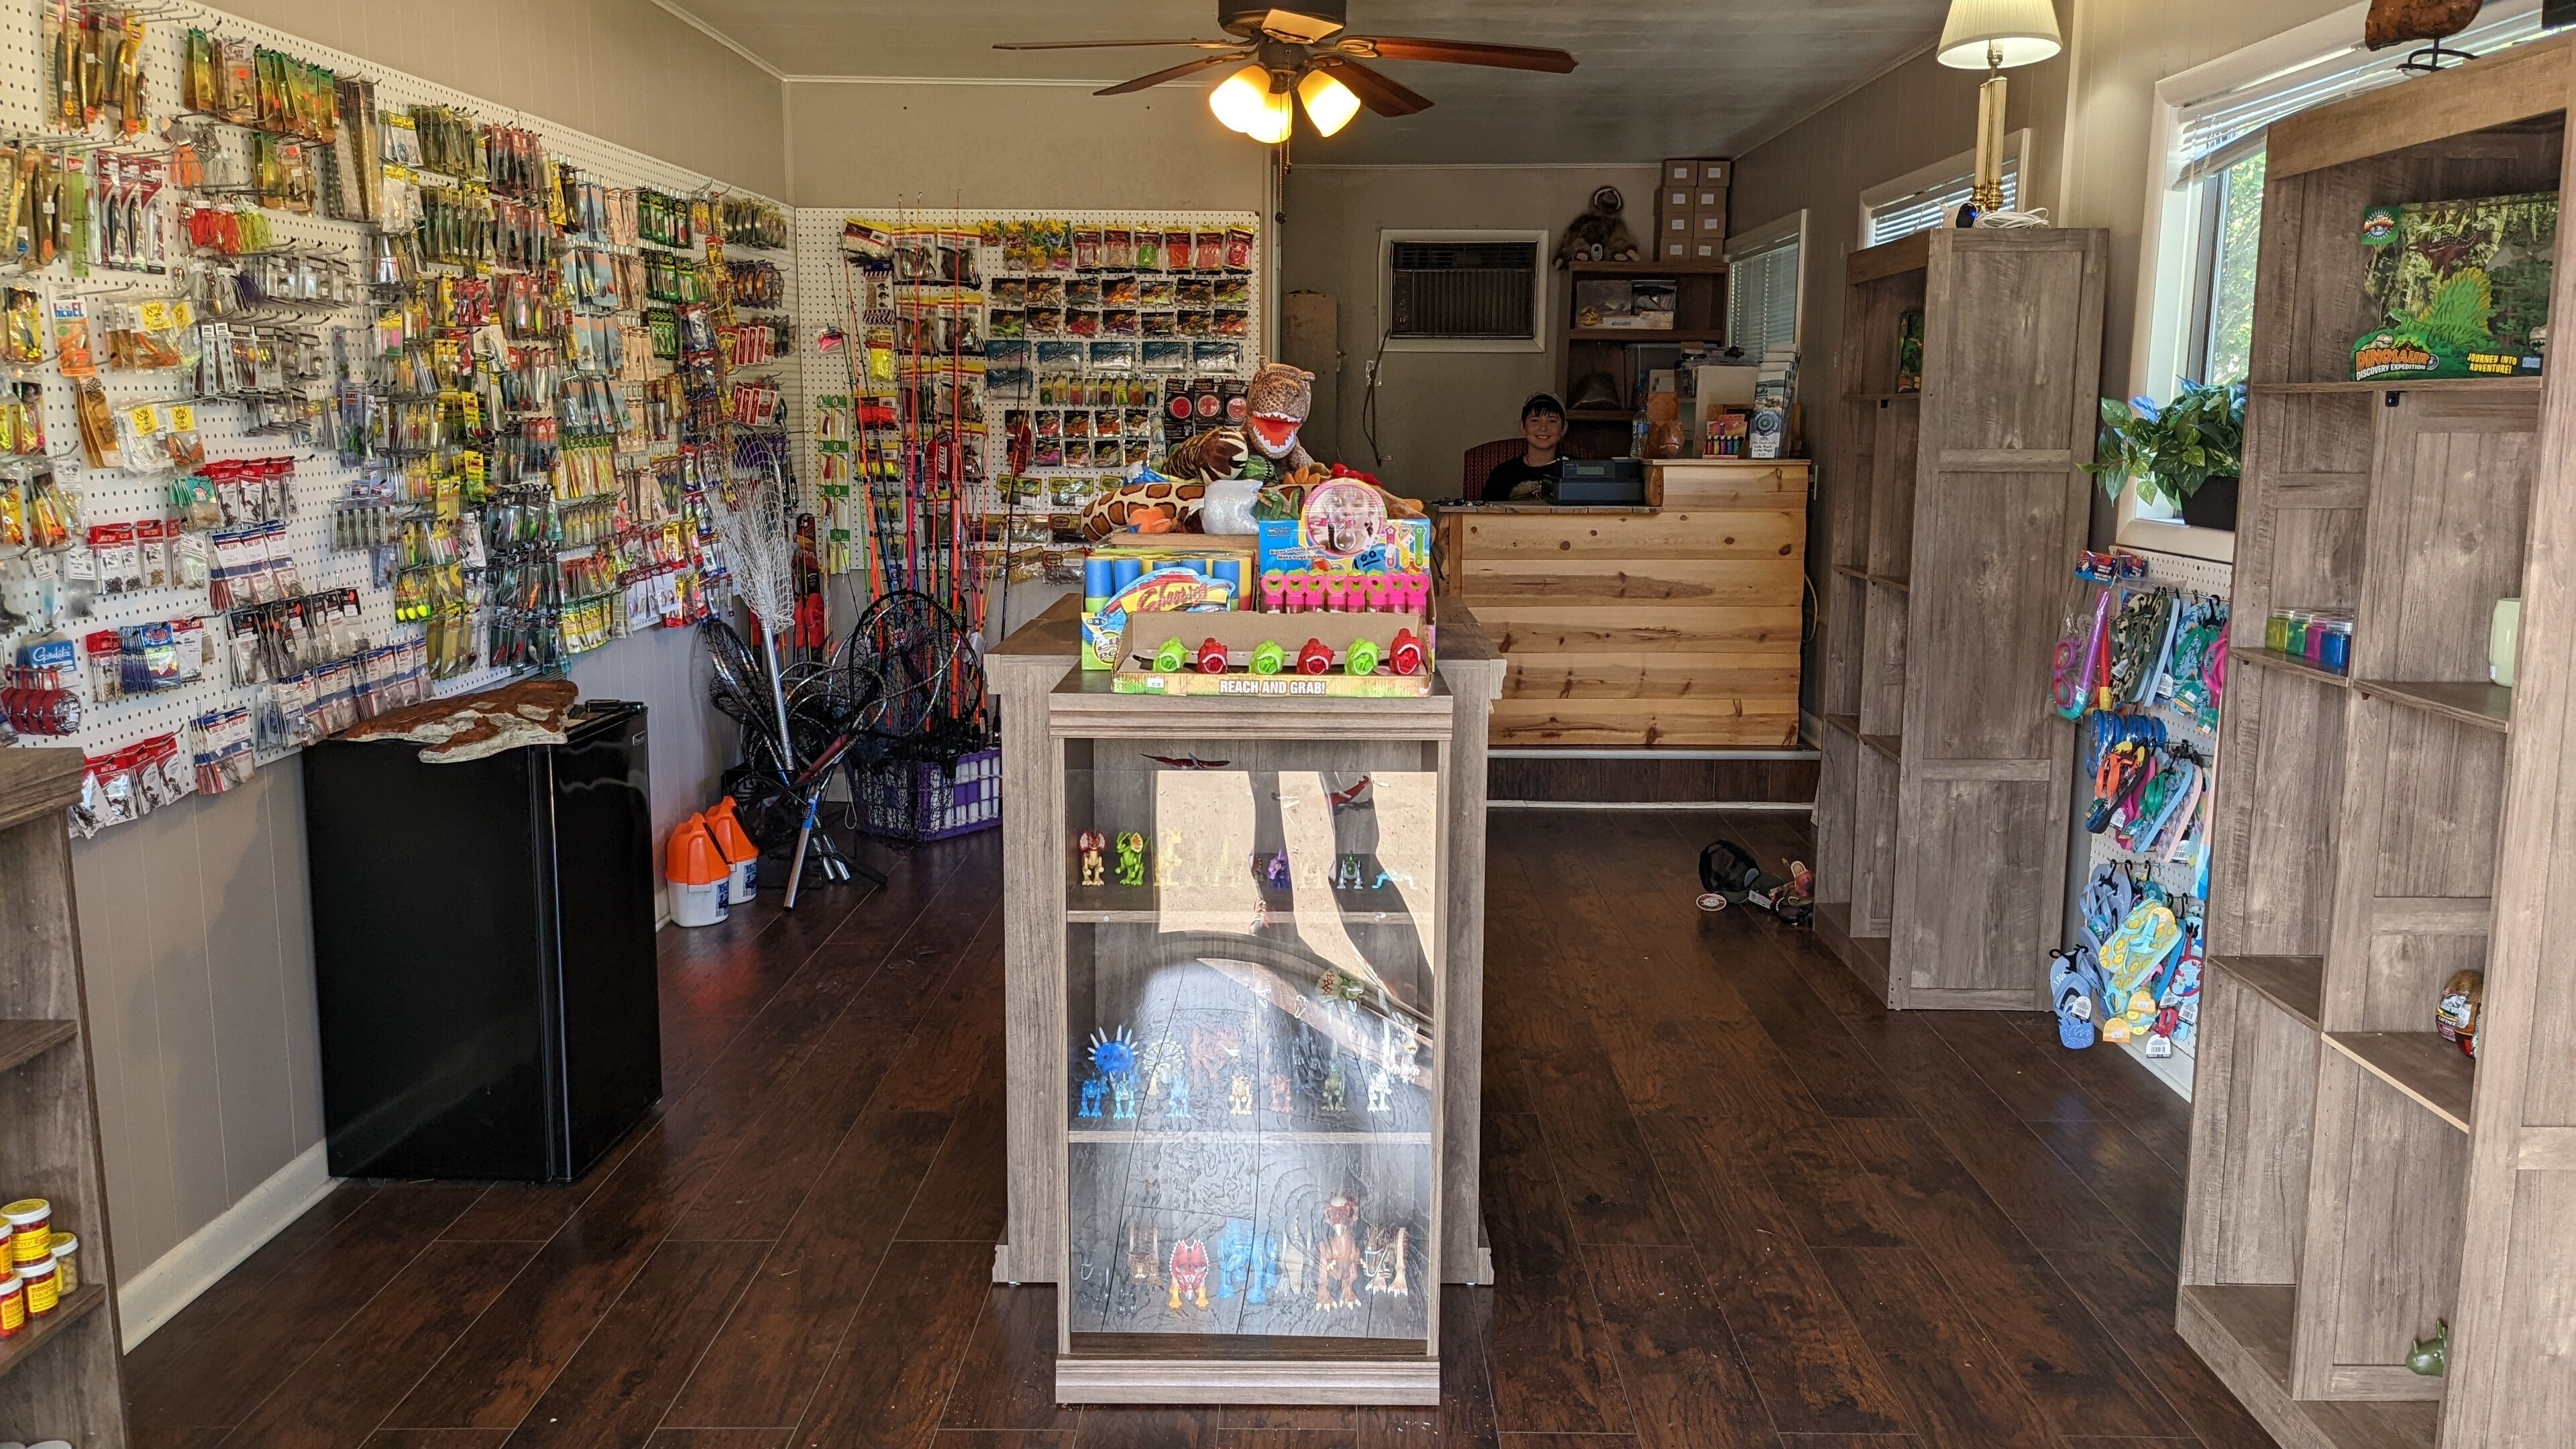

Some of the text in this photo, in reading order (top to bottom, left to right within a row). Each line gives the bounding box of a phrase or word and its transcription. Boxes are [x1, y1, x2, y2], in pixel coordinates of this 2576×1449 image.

[2356, 349, 2430, 371] DINOSAUR
[2467, 353, 2517, 365] JOURNEY INTO
[2356, 364, 2390, 381] DISCOVERY
[2469, 363, 2512, 374] ADVENTURE!
[1220, 680, 1326, 694] REACH AND GRAB!
